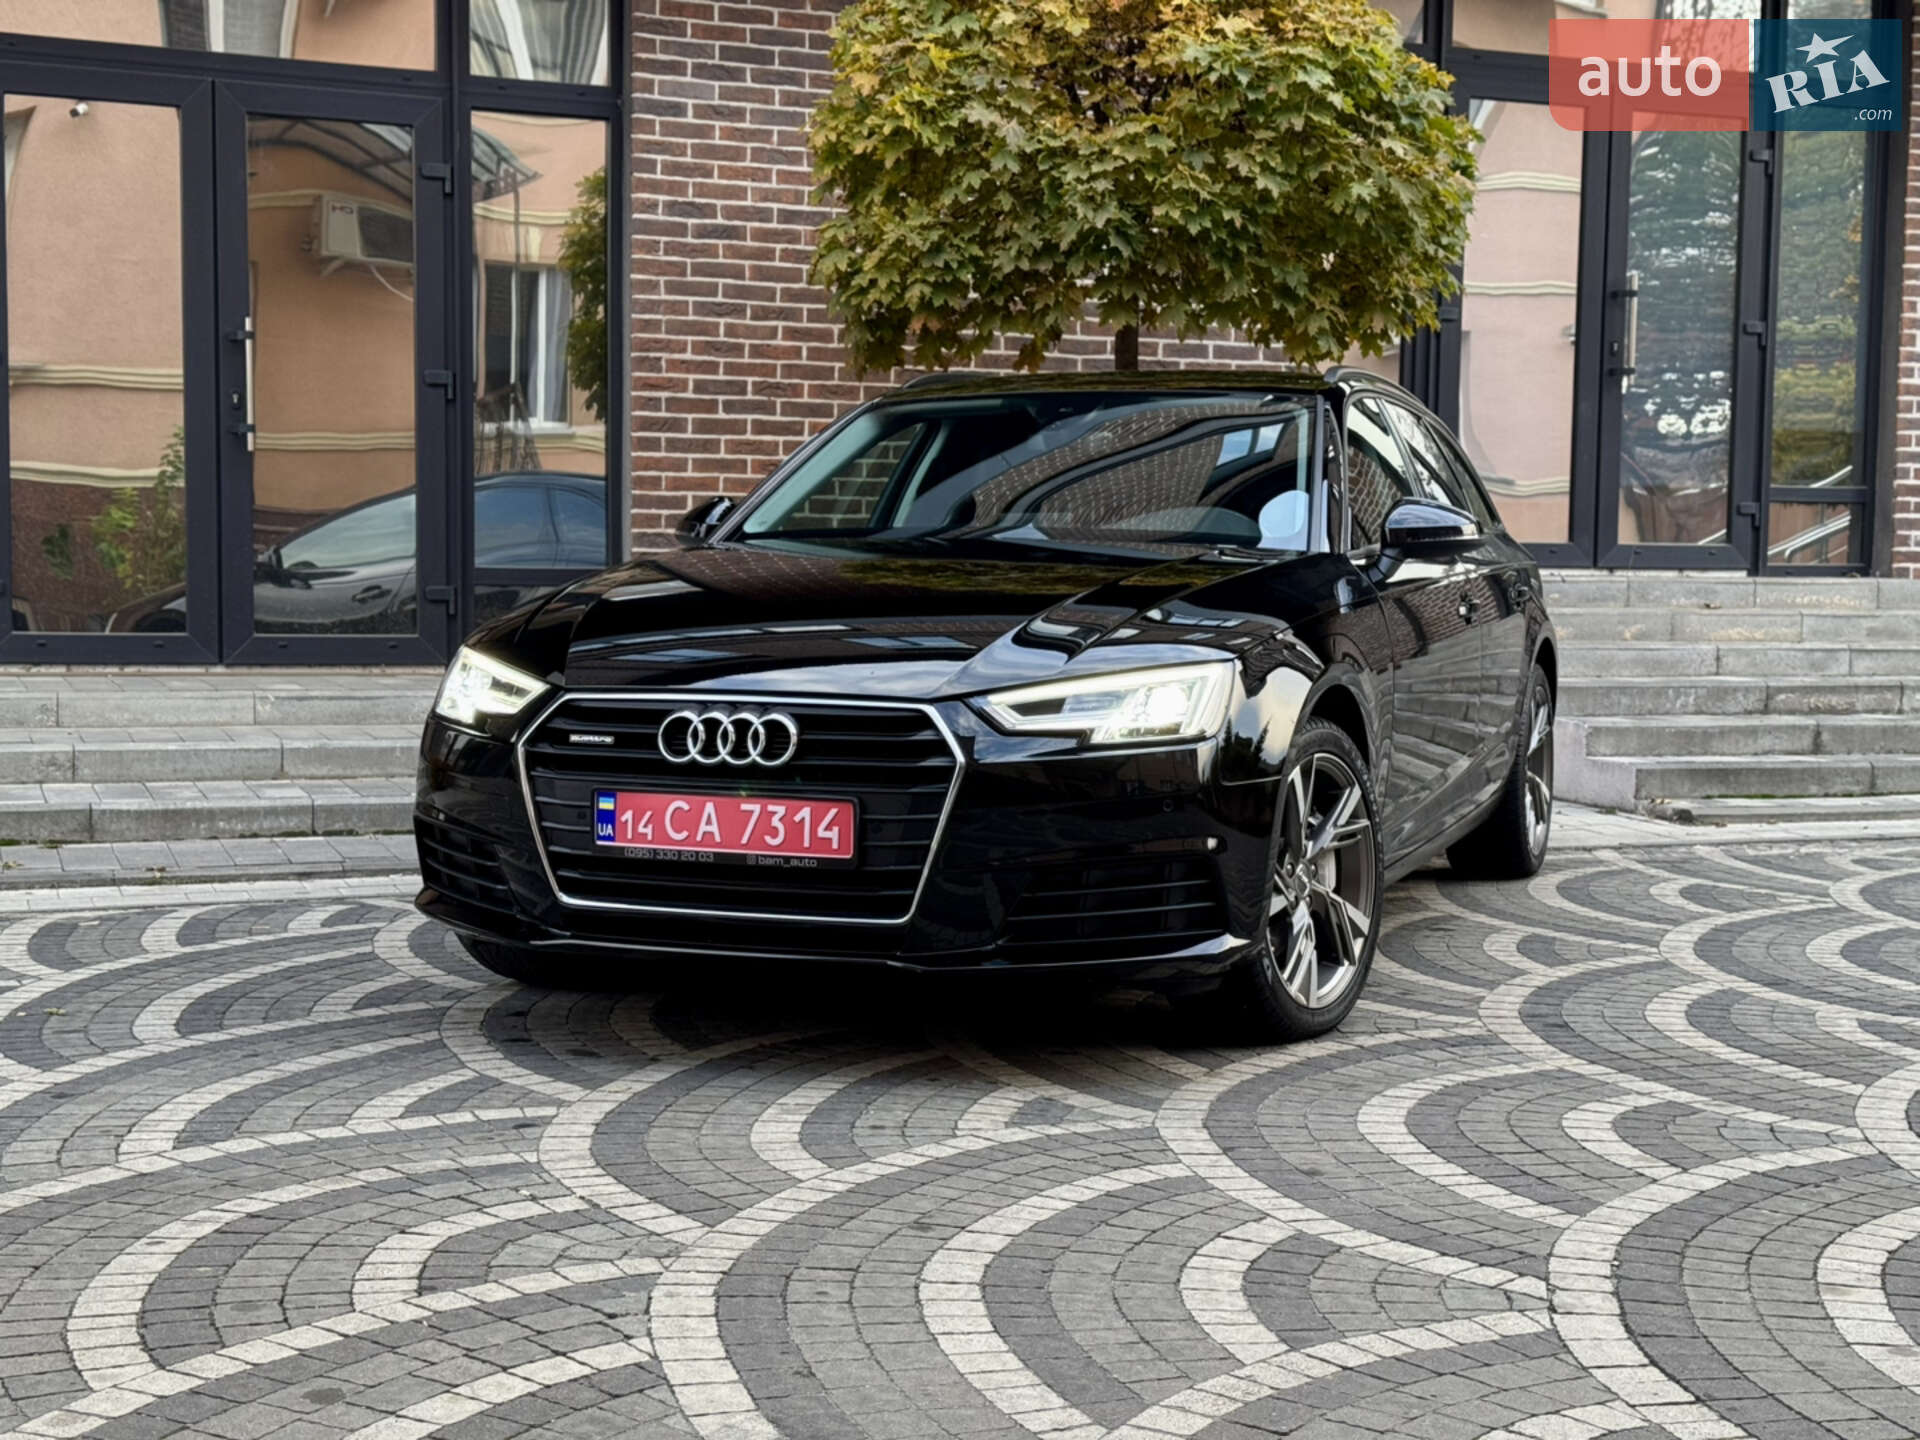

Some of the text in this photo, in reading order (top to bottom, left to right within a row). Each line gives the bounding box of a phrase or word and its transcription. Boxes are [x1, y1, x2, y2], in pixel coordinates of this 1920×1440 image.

[598, 823, 614, 837] UA
[620, 800, 840, 850] 14 CA 7314
[624, 847, 714, 862] (095) 330 20 03
